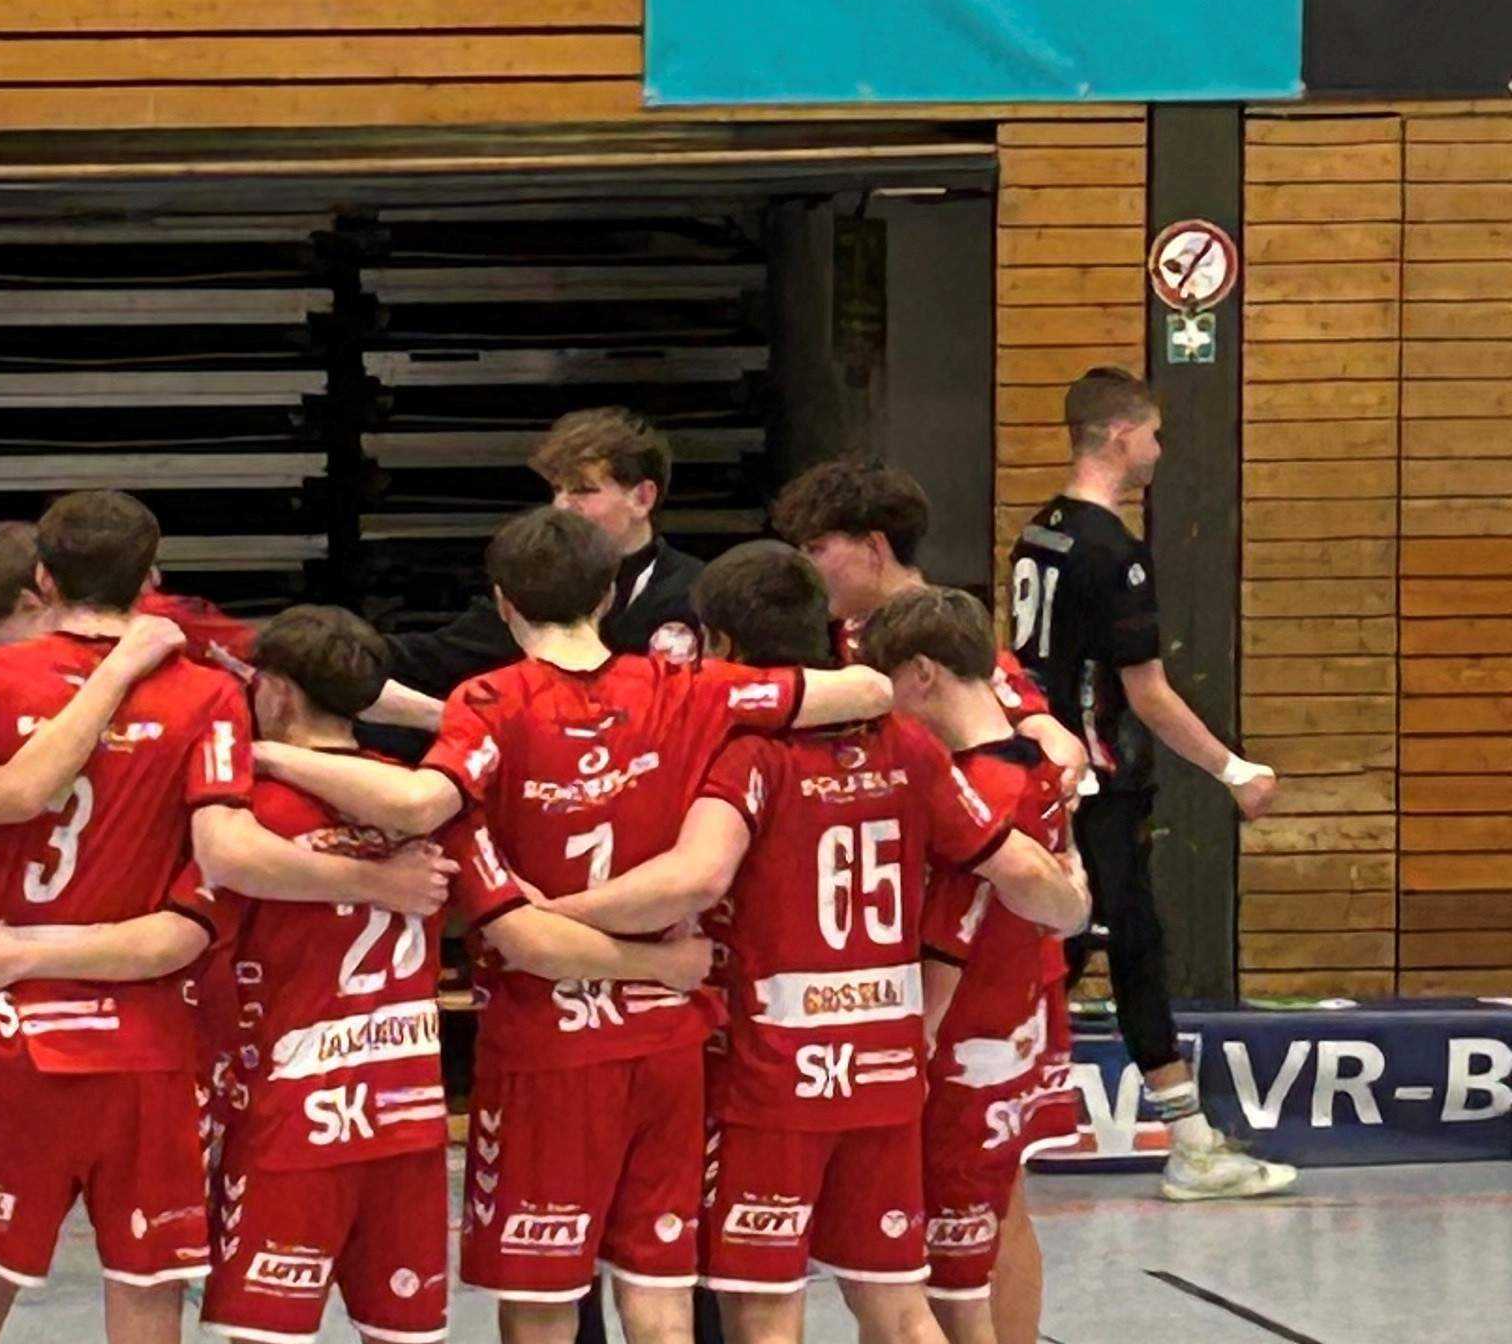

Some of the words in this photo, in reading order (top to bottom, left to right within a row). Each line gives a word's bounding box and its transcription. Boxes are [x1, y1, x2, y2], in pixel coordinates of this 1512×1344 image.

[1012, 557, 1059, 658] 91
[23, 775, 93, 904] 3
[565, 821, 614, 885] 7
[817, 818, 903, 949] 65
[303, 1082, 375, 1145] SK
[795, 1042, 854, 1099] SK
[1222, 1038, 1512, 1131] VR-B
